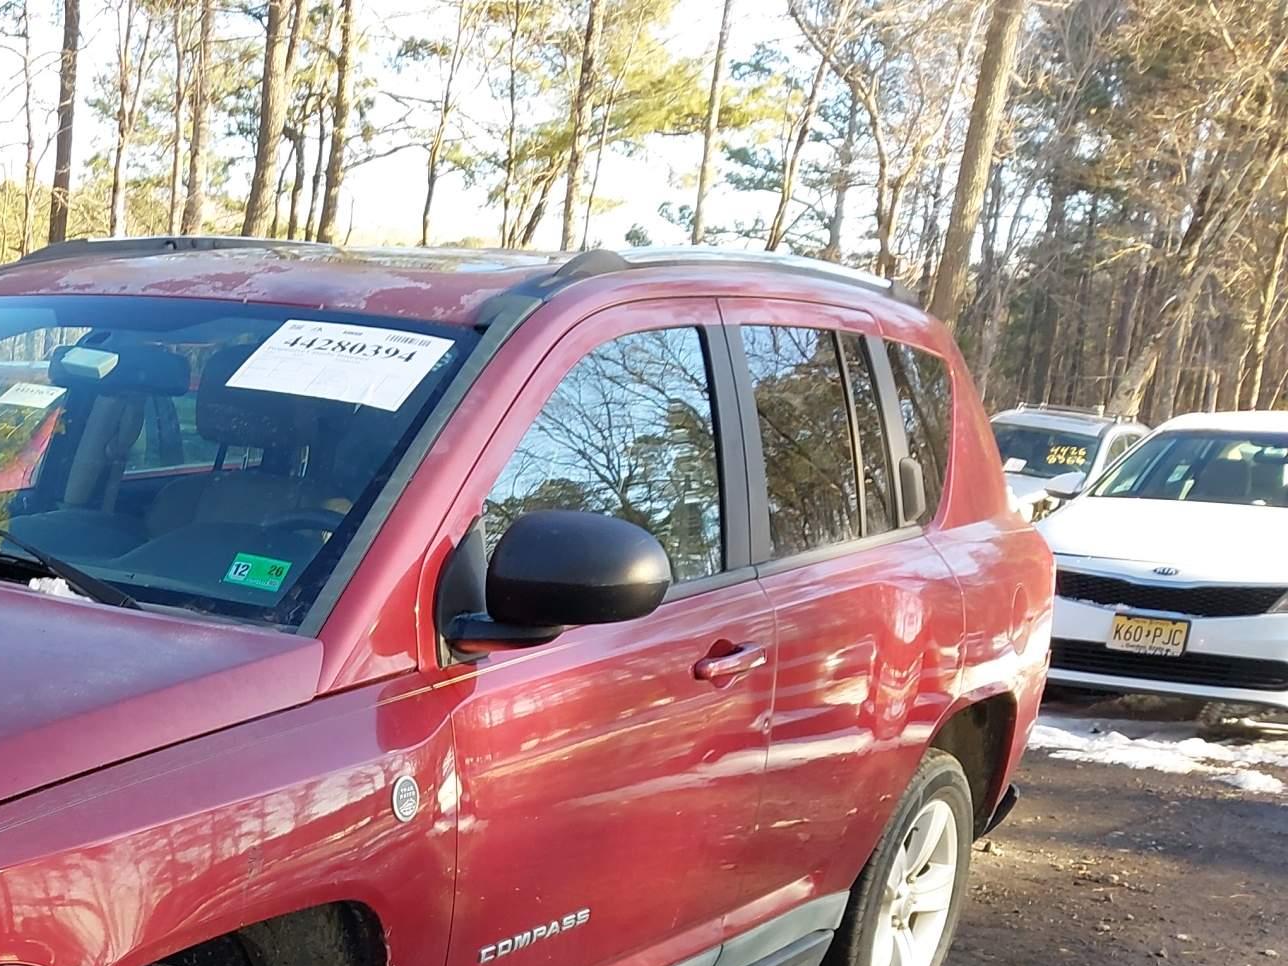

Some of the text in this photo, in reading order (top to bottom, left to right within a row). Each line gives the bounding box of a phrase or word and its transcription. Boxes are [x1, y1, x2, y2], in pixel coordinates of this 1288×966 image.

[283, 335, 417, 362] 44280394
[233, 562, 250, 577] 12
[479, 908, 590, 963] COMPASS
